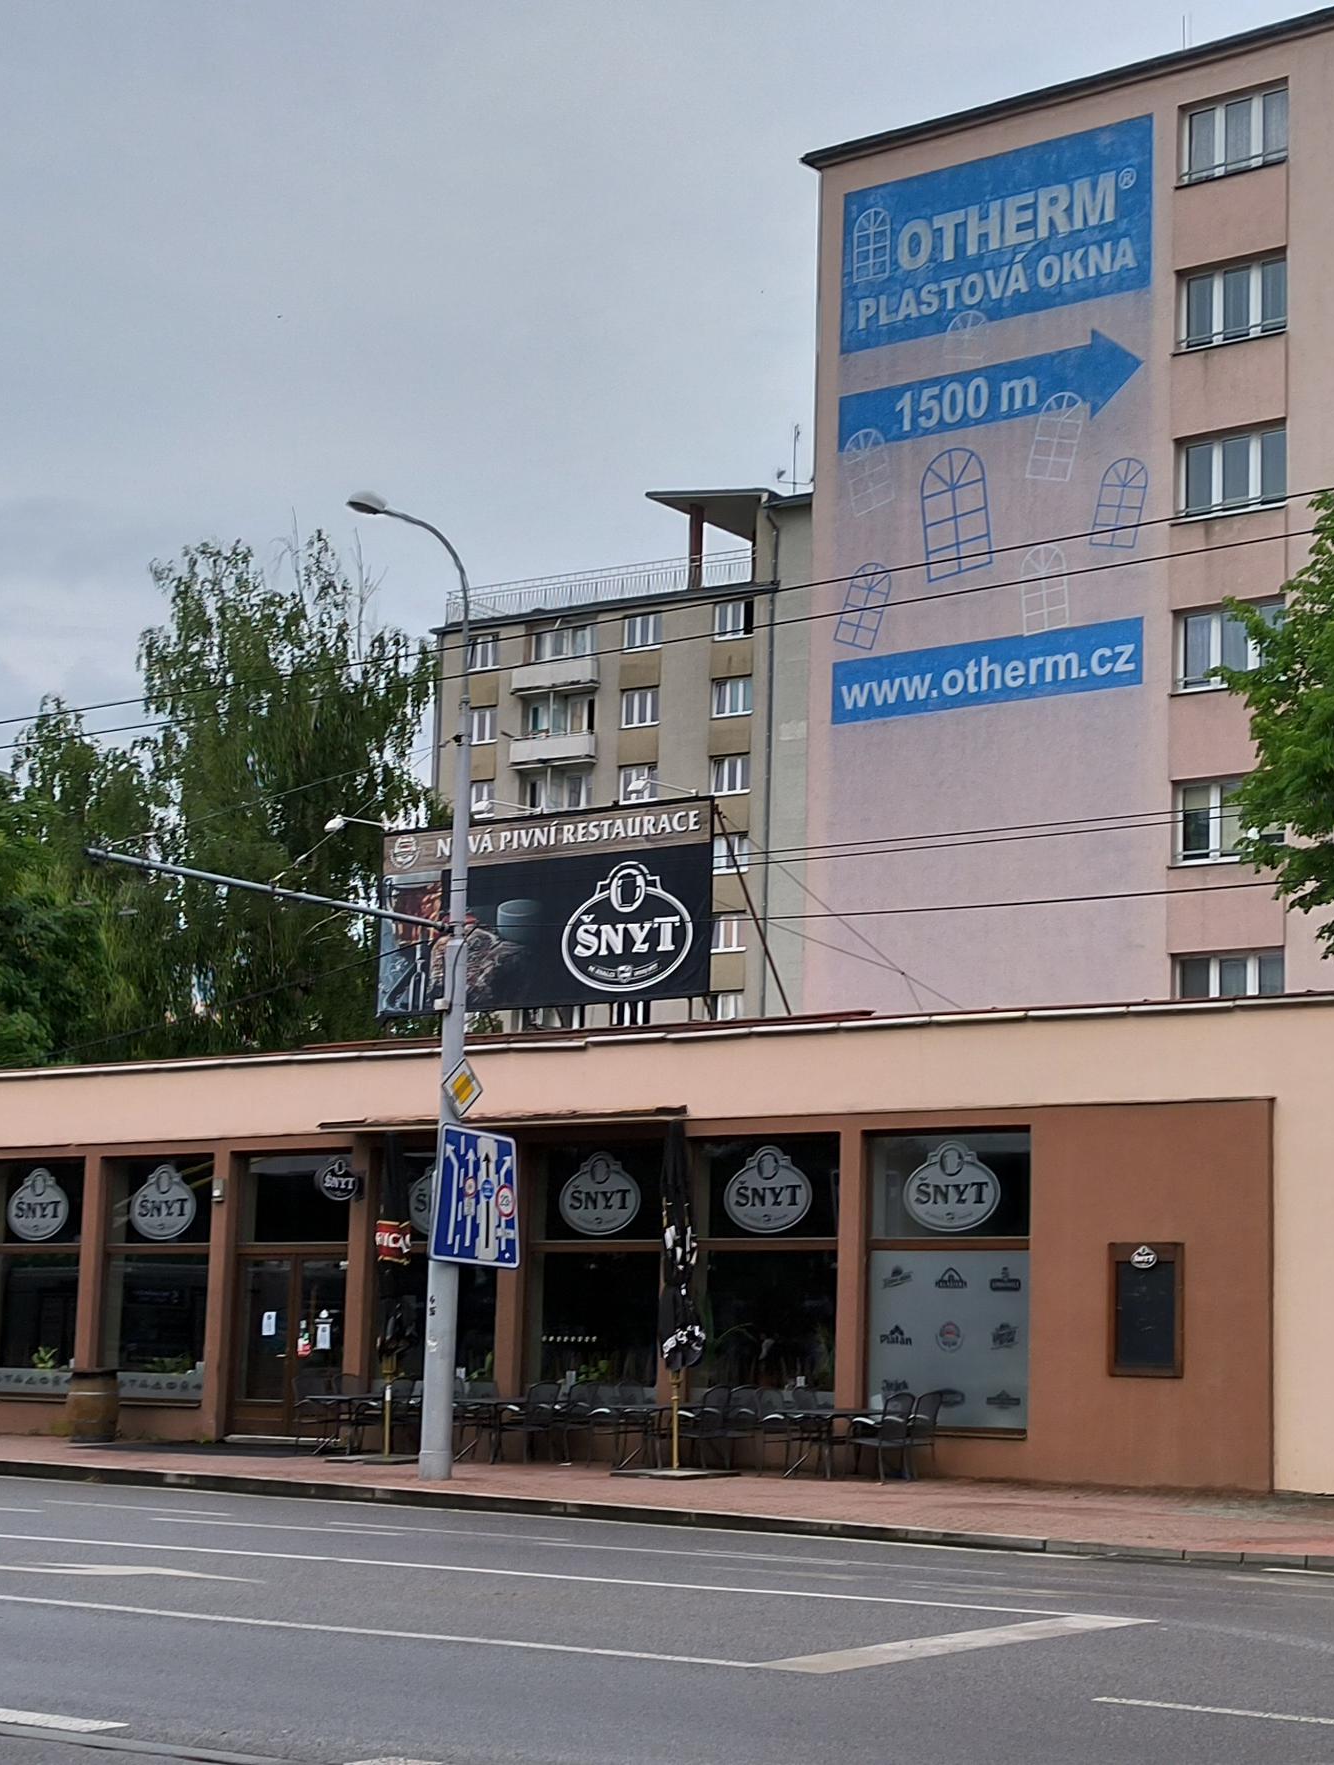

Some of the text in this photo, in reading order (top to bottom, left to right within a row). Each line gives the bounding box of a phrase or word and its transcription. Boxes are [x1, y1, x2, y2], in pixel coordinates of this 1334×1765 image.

[856, 237, 1139, 332] PLASTOVÁ OKNA
[895, 374, 1039, 434] 1500 m
[840, 642, 1137, 711] www.otherm.cz
[436, 810, 702, 859] NVÁ PIVNÍ RESTAURACE
[573, 914, 682, 958] ŠNYT
[323, 1172, 356, 1190] ŠNYT
[733, 1180, 803, 1207] ŠNYT
[914, 1176, 989, 1205] ŠNYT
[13, 1194, 62, 1220] ŠNYT
[137, 1193, 189, 1218] ŠNYT
[568, 1184, 632, 1211] ŠNYT
